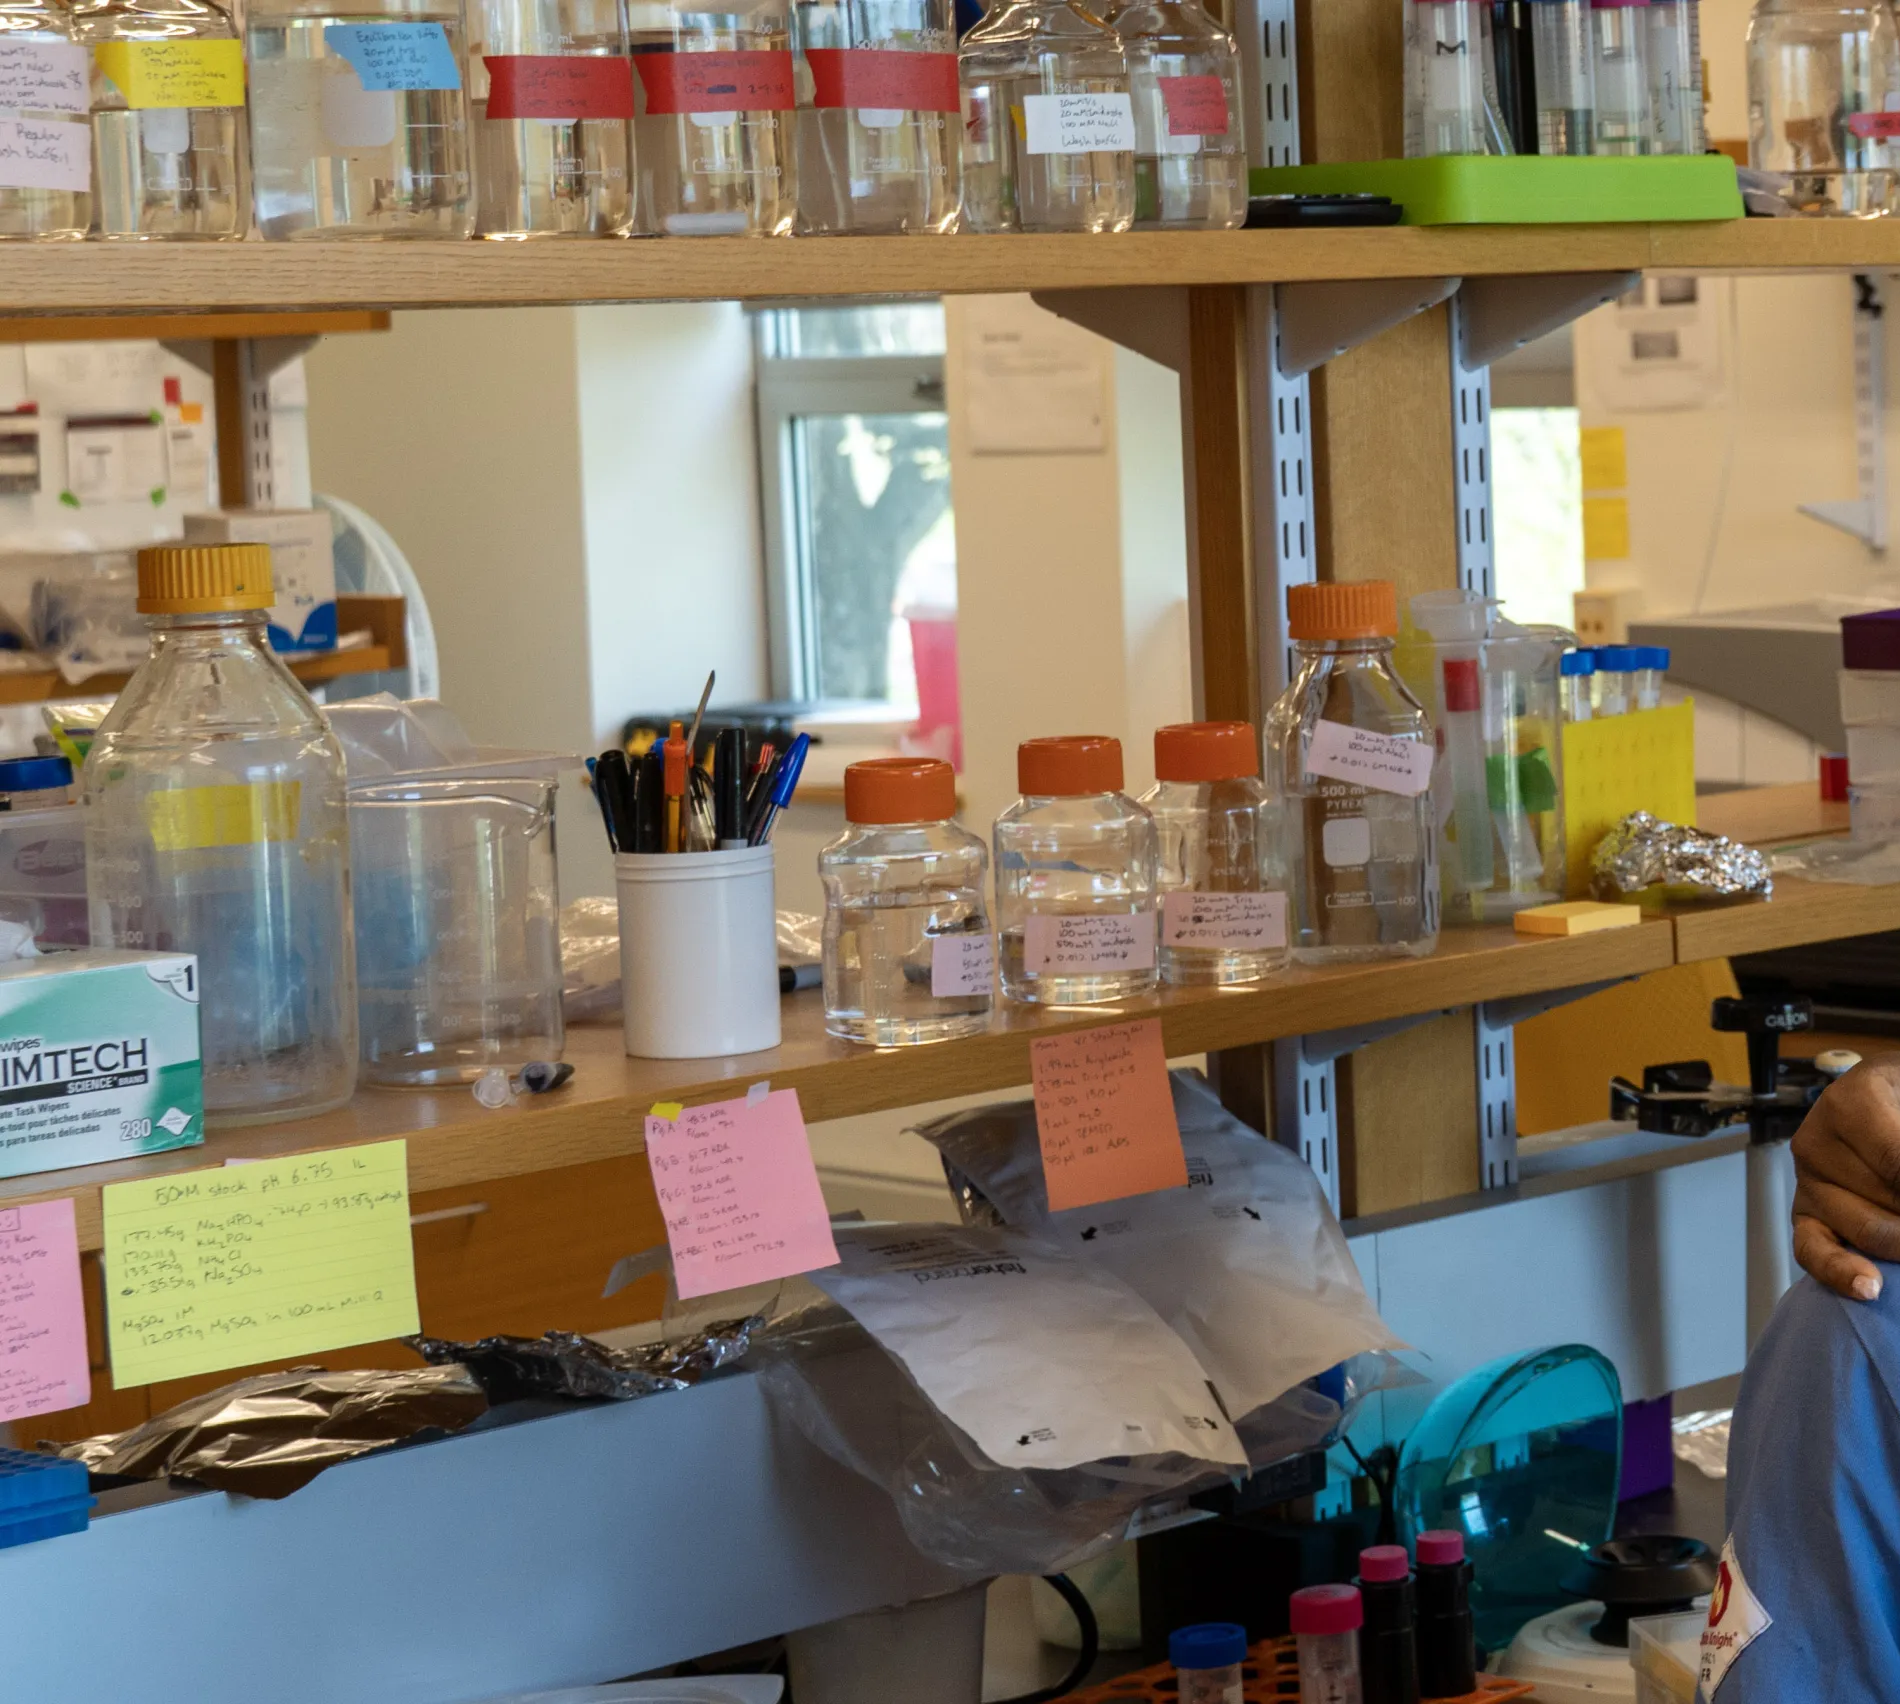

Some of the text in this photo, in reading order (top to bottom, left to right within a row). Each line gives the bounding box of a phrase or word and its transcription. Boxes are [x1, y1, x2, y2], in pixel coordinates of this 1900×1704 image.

[930, 166, 947, 177] 100
[1321, 785, 1346, 797] 500
[1326, 800, 1364, 810] PYREX
[1397, 896, 1416, 906] 100
[184, 964, 195, 993] 1
[15, 1105, 36, 1118] Task
[39, 1100, 71, 1116] Wipers
[28, 1118, 48, 1132] pour
[120, 1118, 152, 1142] 280
[6, 1136, 28, 1151] para
[28, 1132, 58, 1146] tareas
[208, 1182, 248, 1198] stock
[261, 1174, 280, 1193] pH
[292, 1161, 333, 1184] 6.75
[288, 1301, 313, 1317] 100
